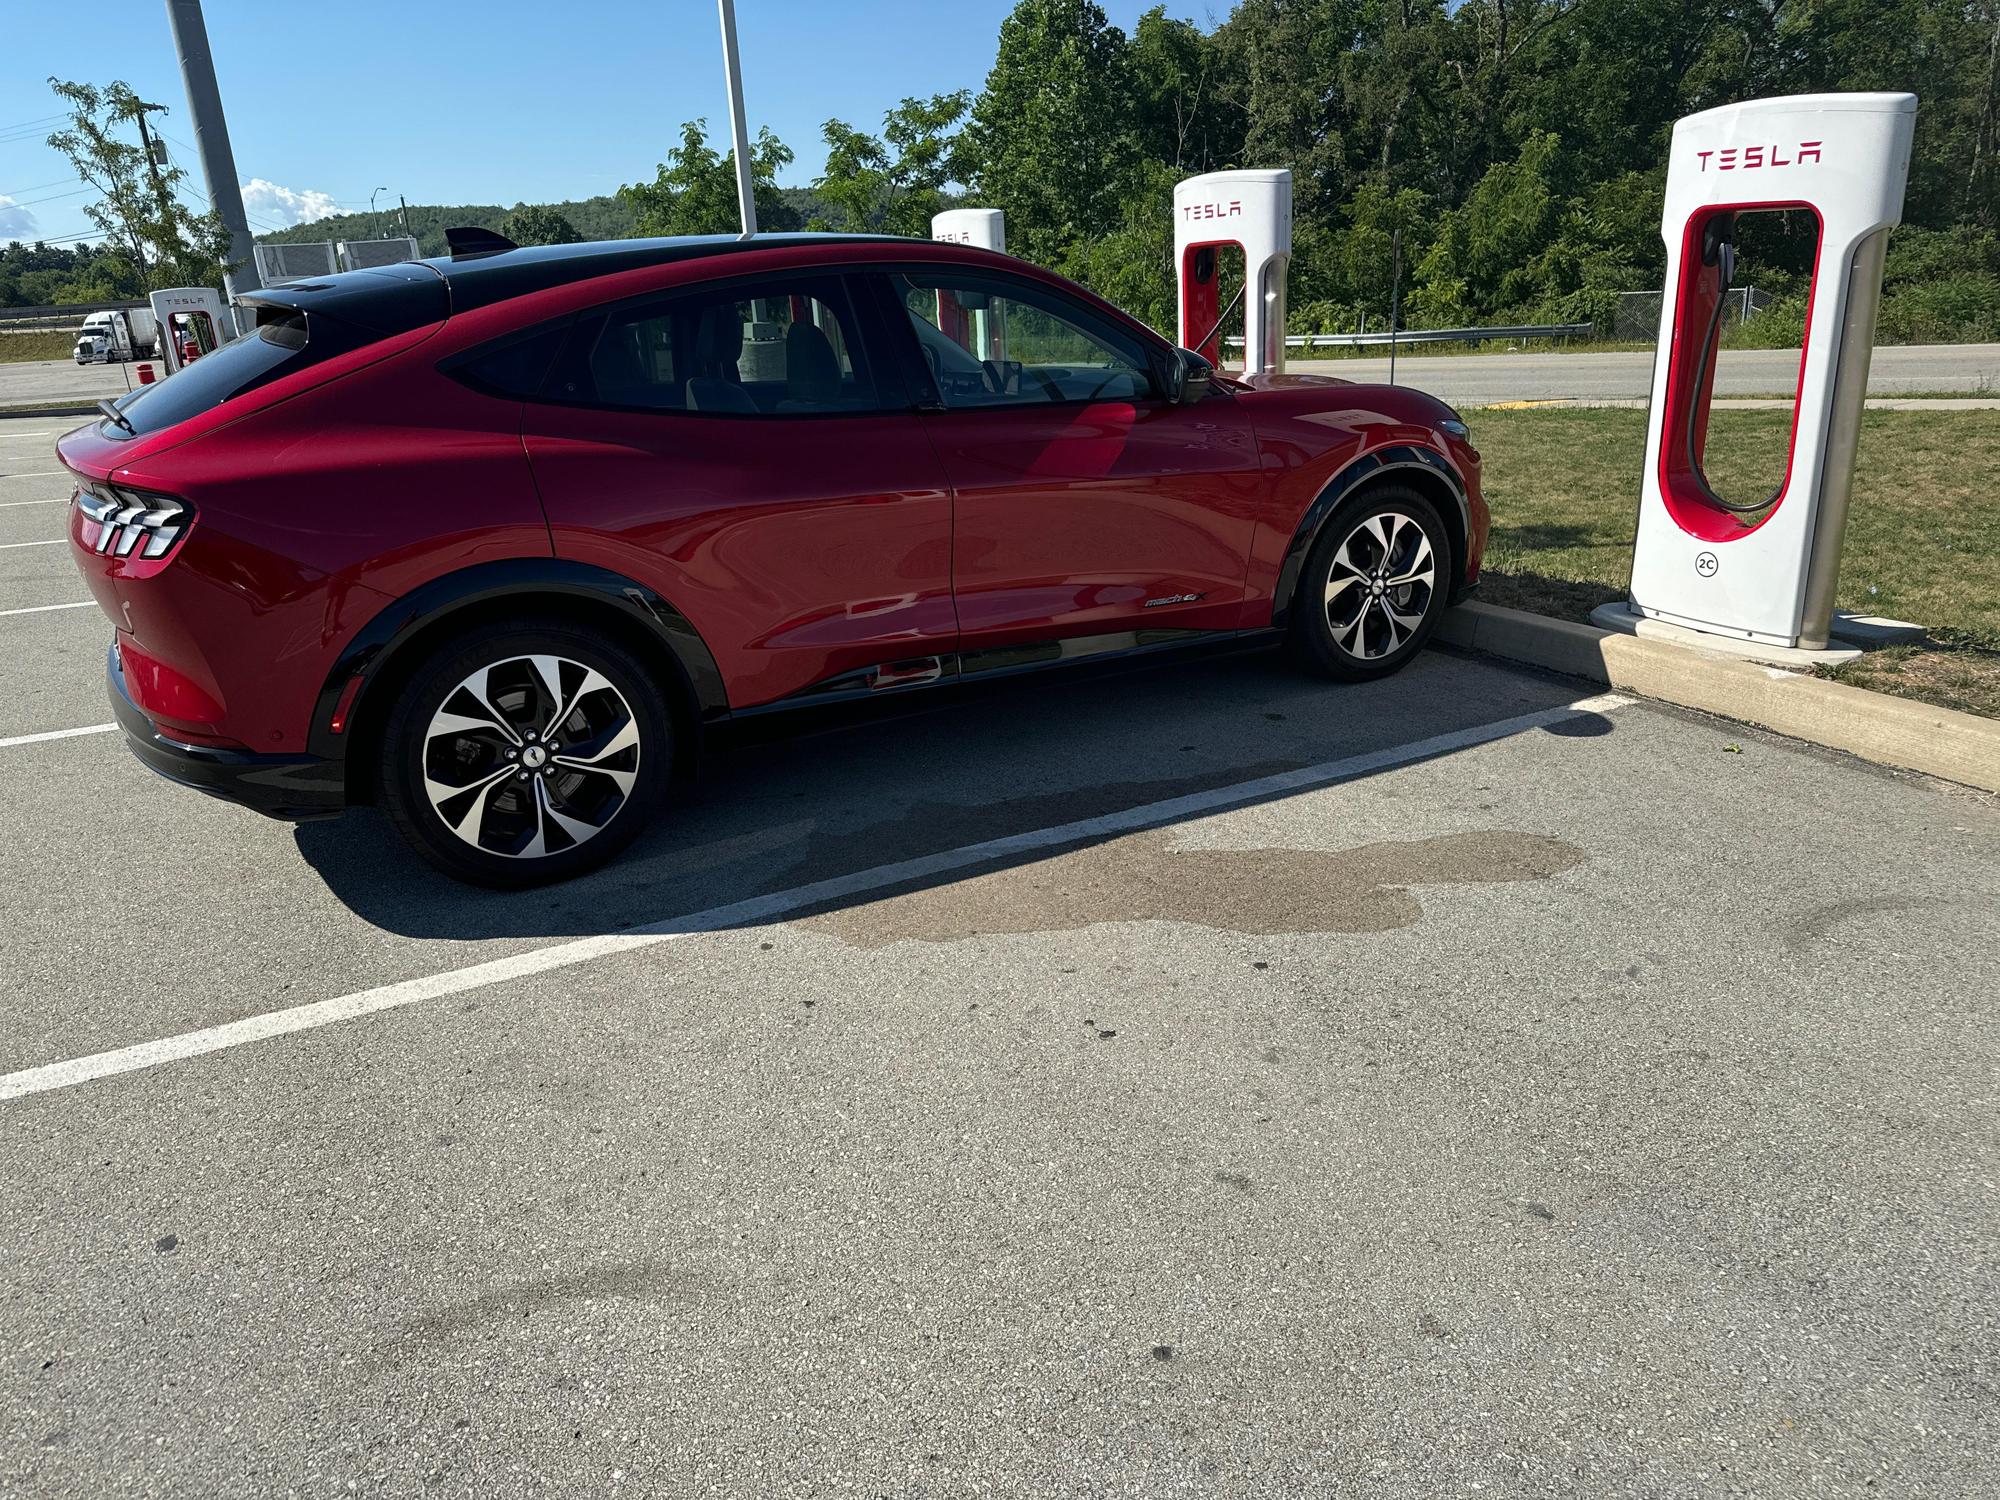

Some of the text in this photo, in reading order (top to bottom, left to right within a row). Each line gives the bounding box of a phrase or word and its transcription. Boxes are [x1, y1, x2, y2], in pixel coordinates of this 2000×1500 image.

[1697, 141, 1823, 172] TESLA
[1183, 201, 1241, 221] TESLA
[165, 297, 205, 305] TESLA
[1699, 558, 1715, 570] 2C
